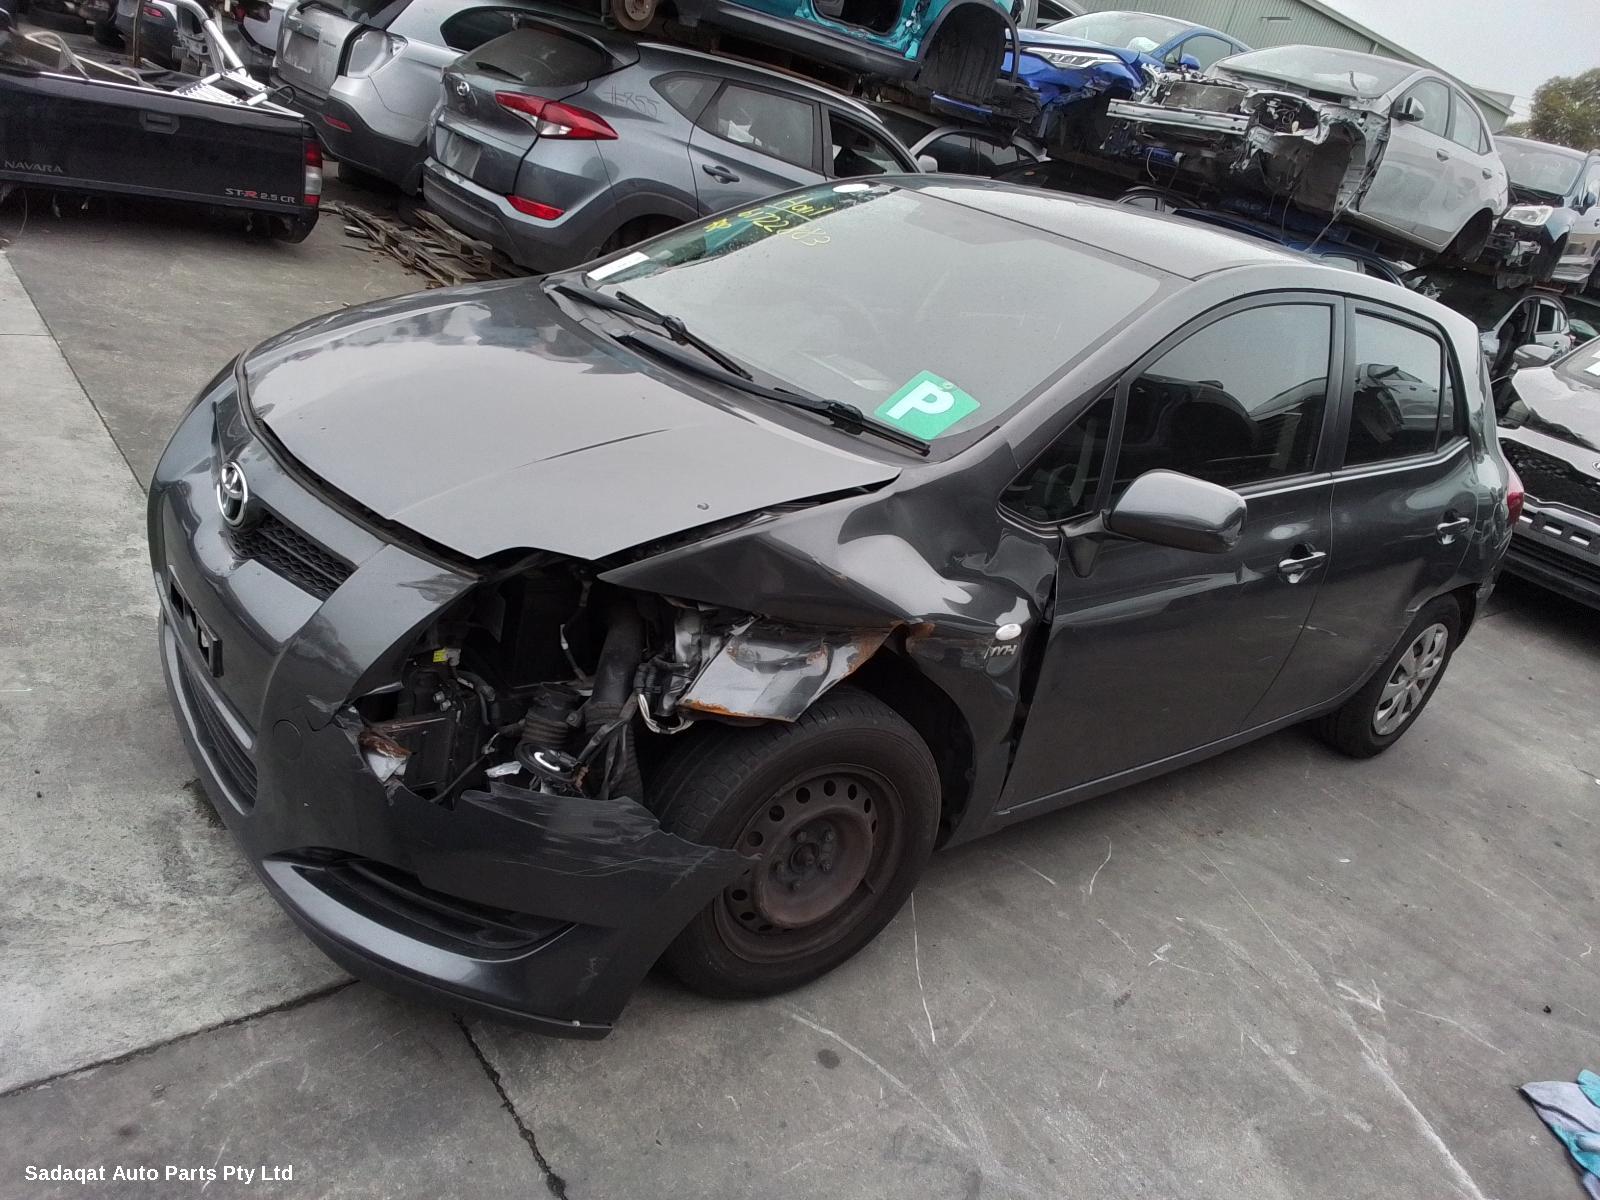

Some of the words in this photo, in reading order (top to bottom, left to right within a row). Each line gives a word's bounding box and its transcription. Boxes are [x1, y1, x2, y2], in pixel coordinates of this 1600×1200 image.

[4, 160, 63, 173] NAVARA
[280, 195, 296, 204] CR
[885, 380, 955, 420] P
